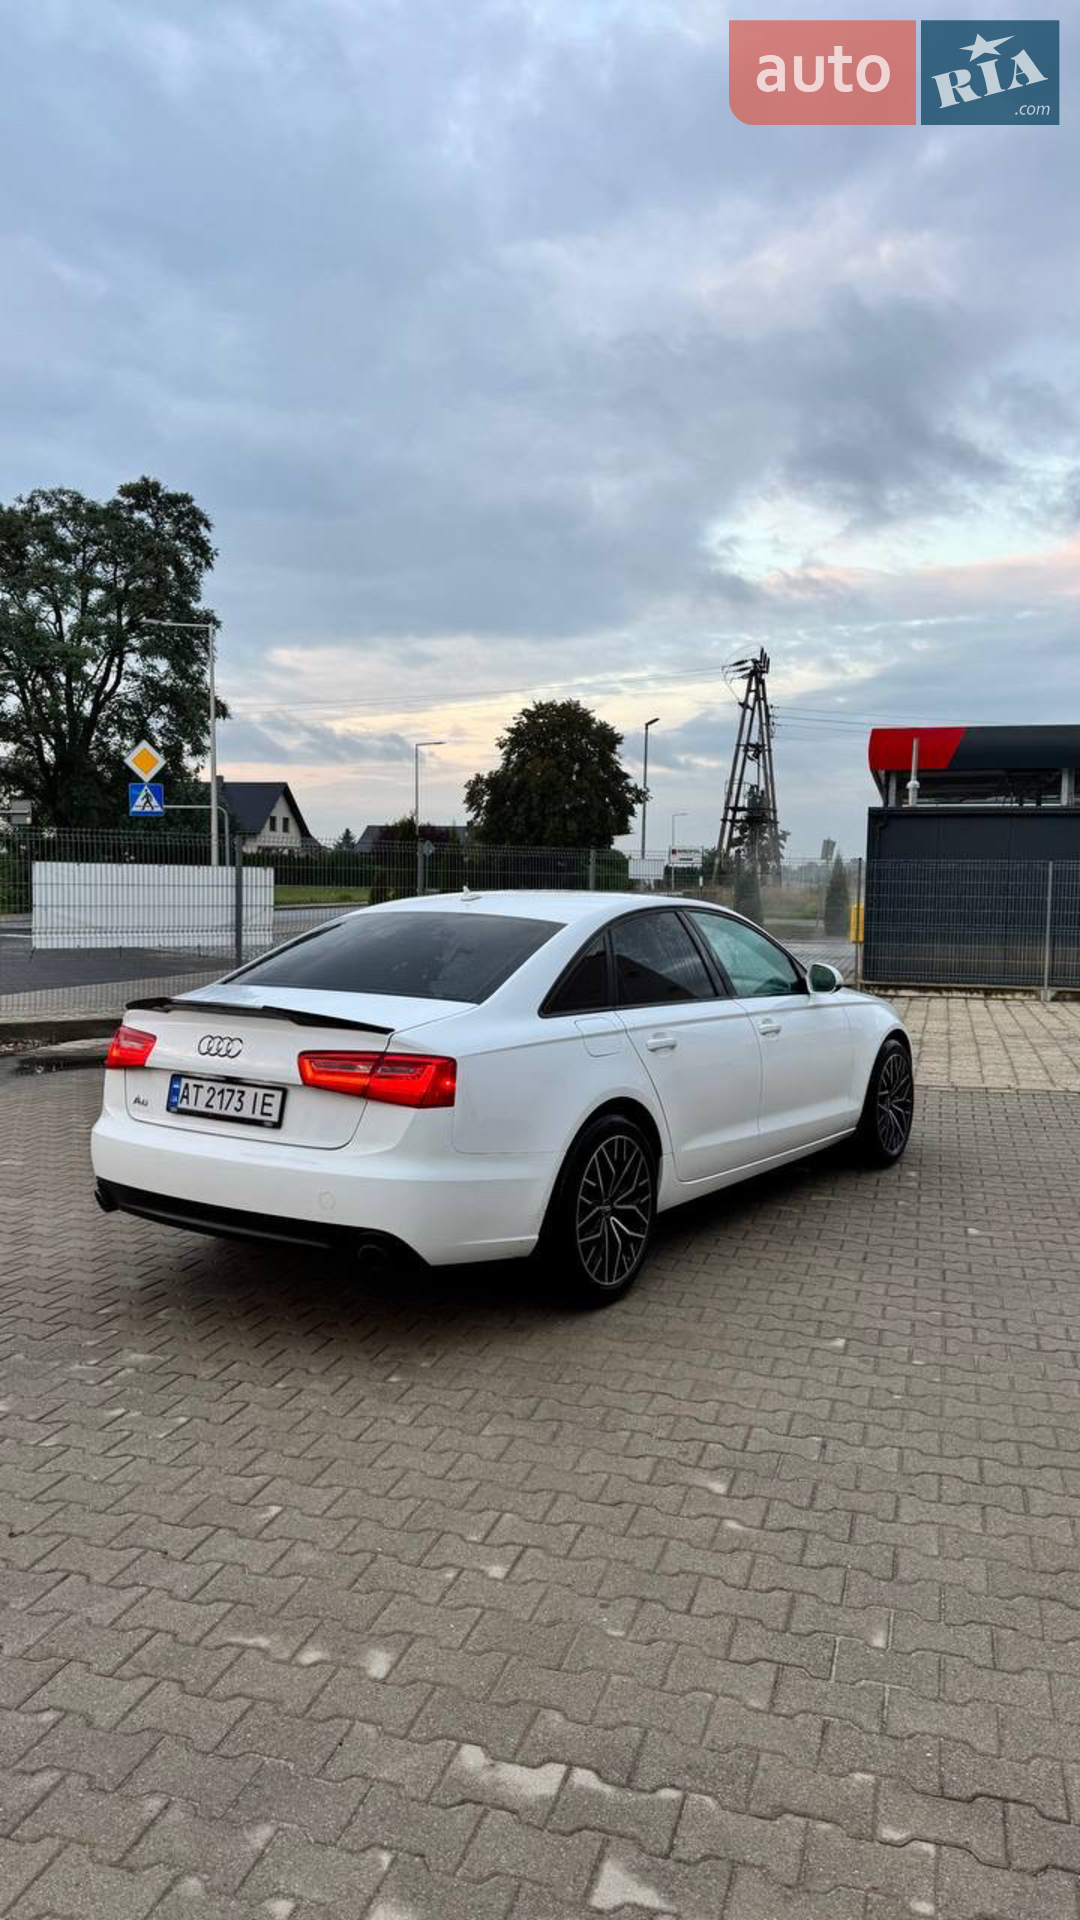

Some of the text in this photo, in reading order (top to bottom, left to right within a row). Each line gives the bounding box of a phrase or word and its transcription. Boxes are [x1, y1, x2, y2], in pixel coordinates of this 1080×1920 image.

[179, 1083, 204, 1107] AT
[205, 1086, 246, 1112] 2173
[251, 1092, 276, 1117] IE
